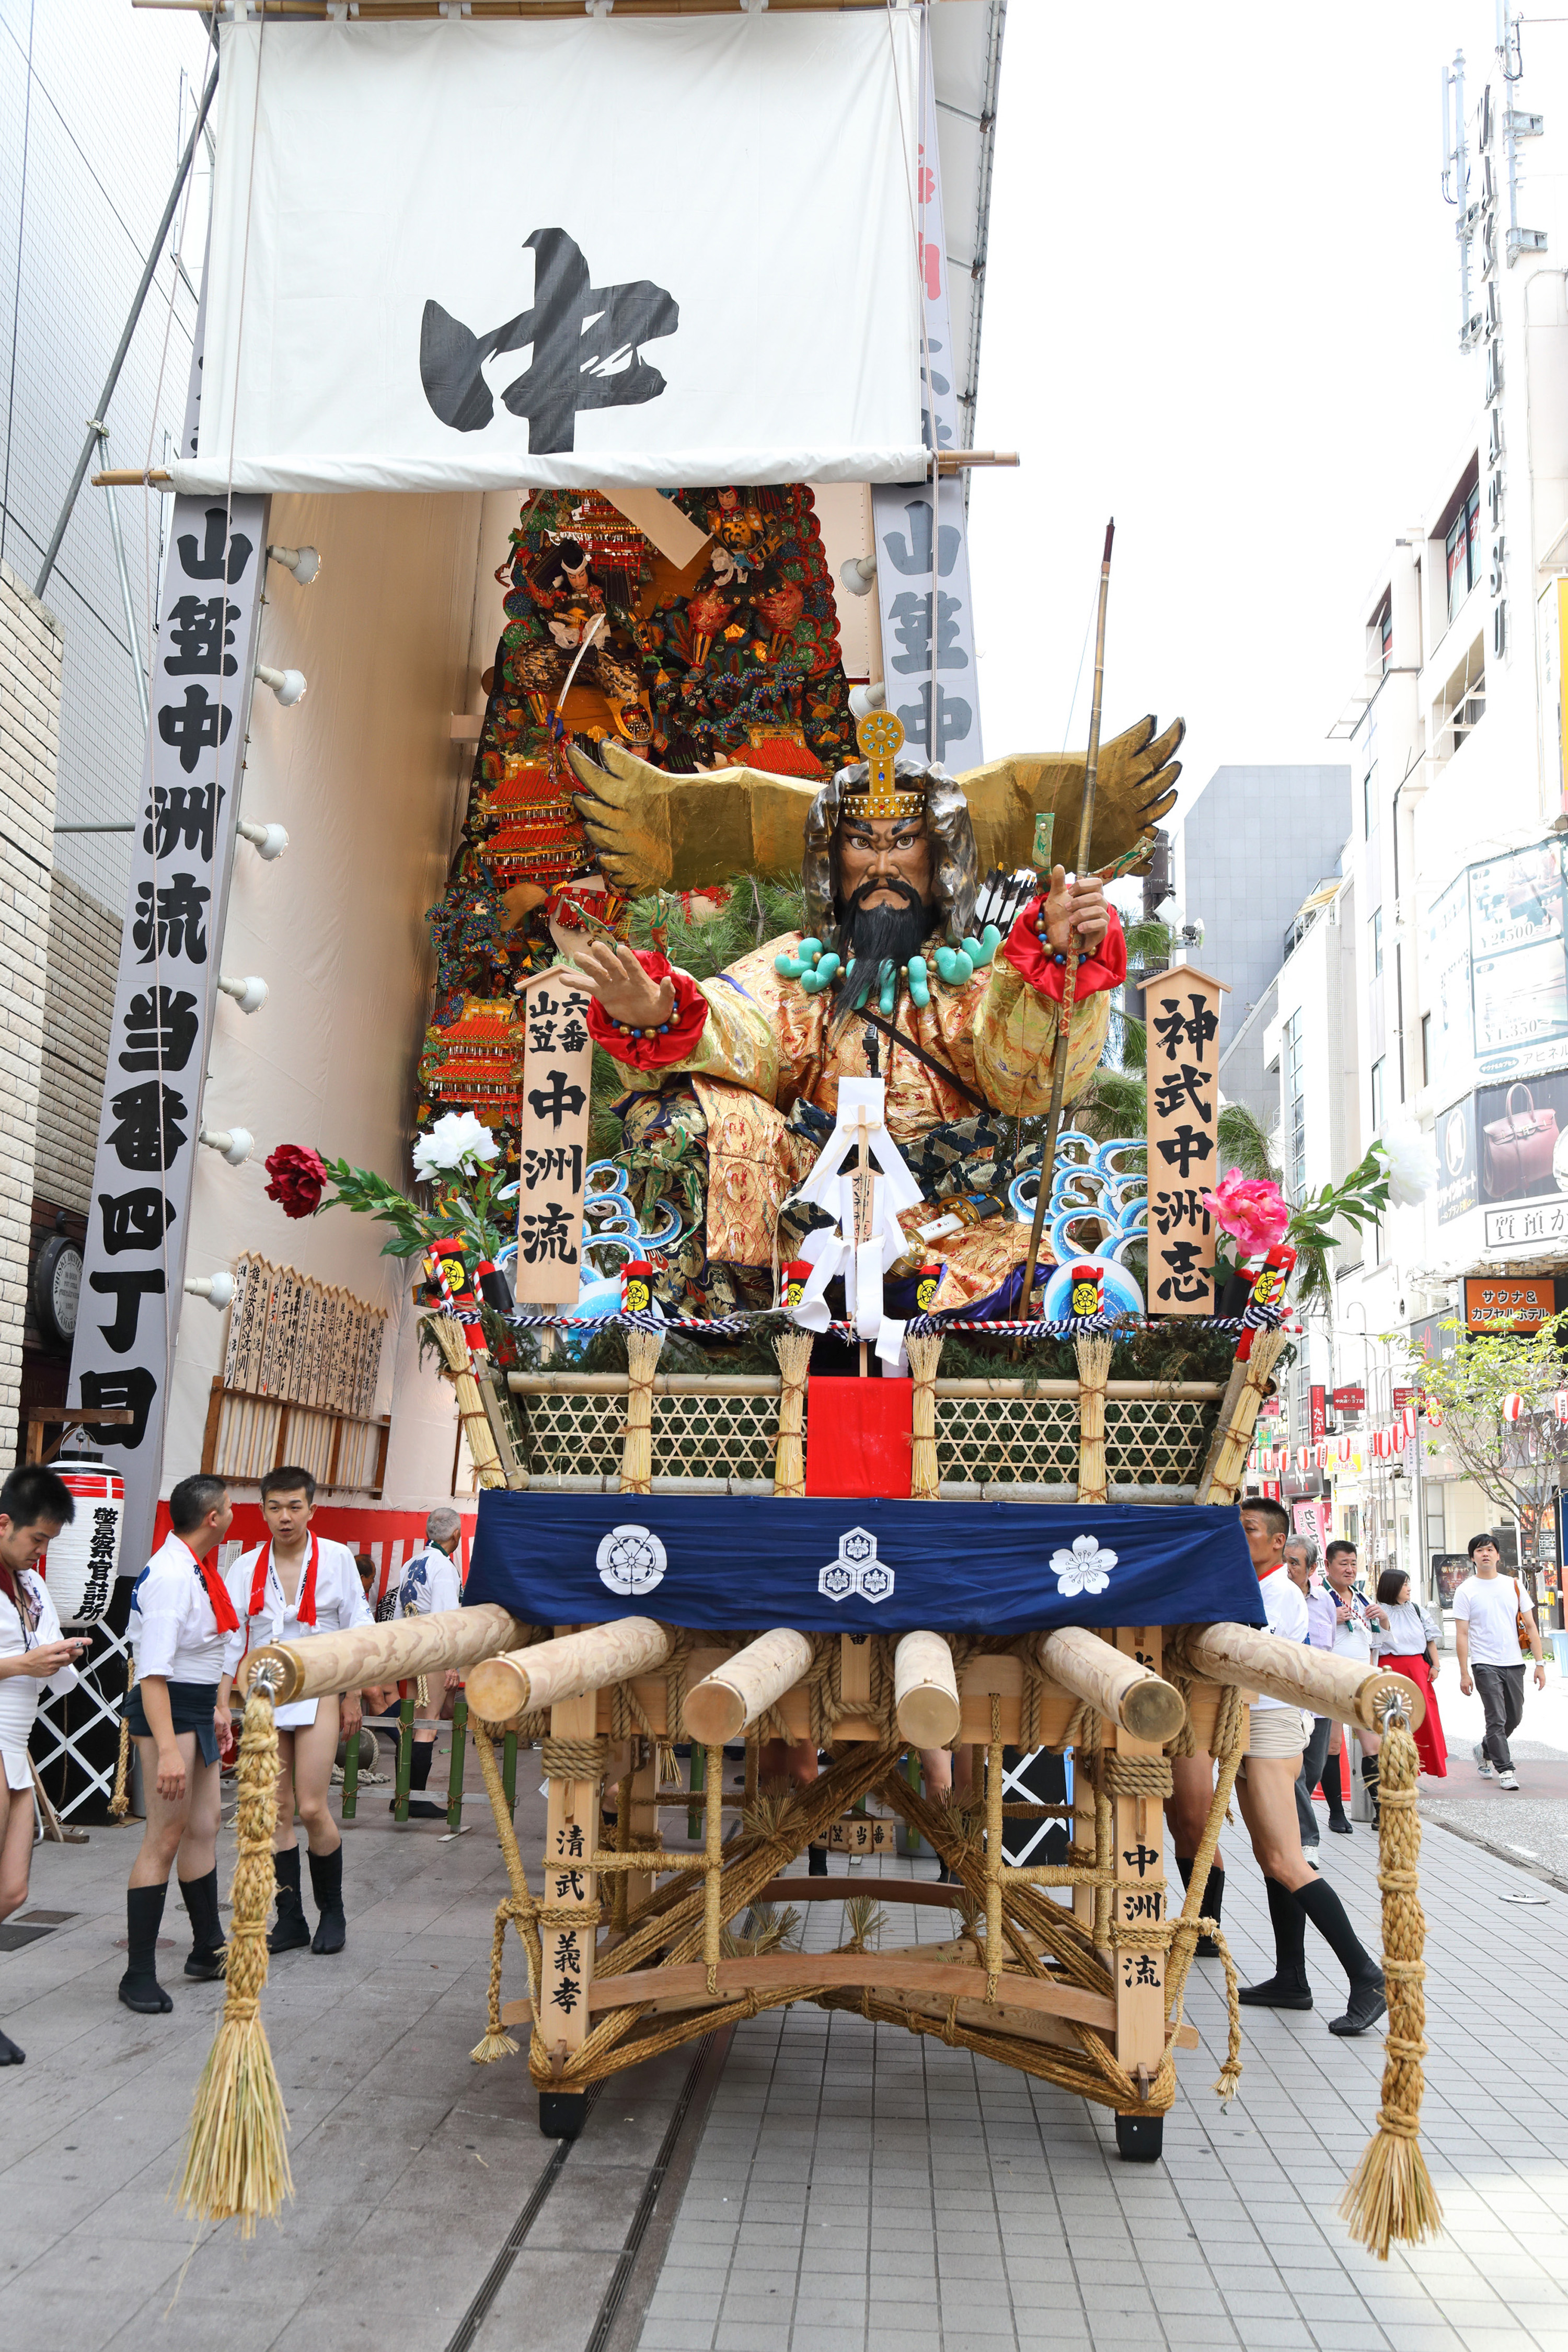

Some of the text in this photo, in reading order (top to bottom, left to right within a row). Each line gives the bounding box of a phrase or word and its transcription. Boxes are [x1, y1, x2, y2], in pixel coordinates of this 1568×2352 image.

[528, 991, 559, 1053] 山笠
[557, 992, 589, 1053] 六番
[522, 1070, 586, 1265] 中洲流
[1152, 994, 1219, 1302] 神武中洲志
[1471, 1307, 1550, 1322] カプセルホテル
[1482, 1290, 1538, 1305] サウナ&
[73, 1507, 119, 1621] 警察官詰所
[549, 1824, 585, 2014] 清武義孝
[1123, 1844, 1162, 1988] 中洲流
